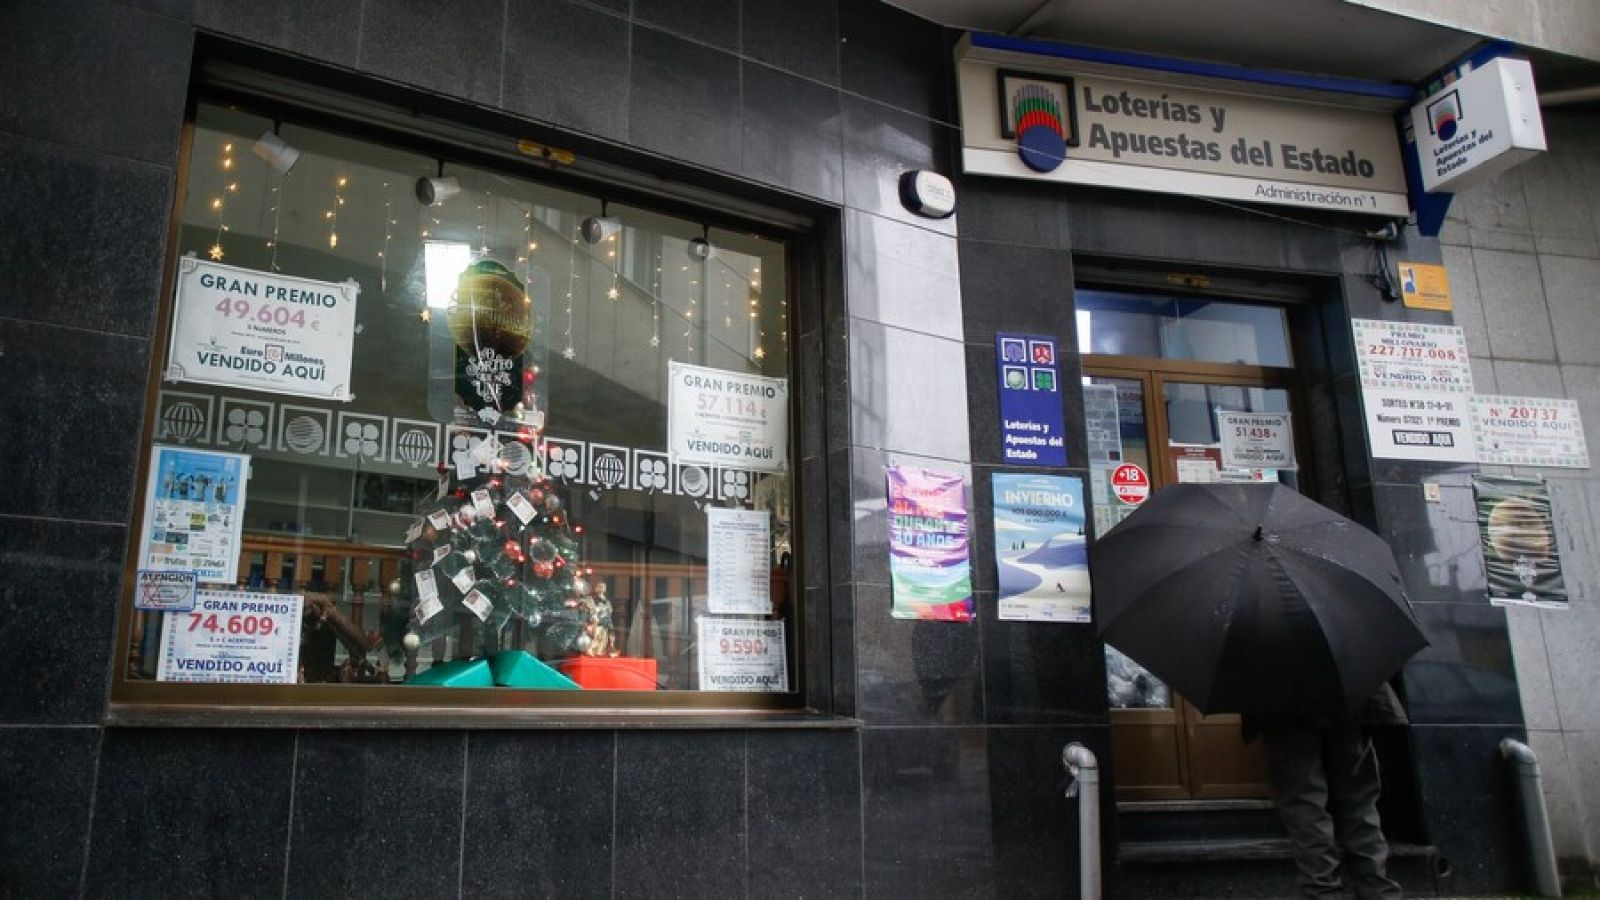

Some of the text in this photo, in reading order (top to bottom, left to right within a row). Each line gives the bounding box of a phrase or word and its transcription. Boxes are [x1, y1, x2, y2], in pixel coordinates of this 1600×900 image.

[1083, 86, 1226, 133] Loterías y
[1478, 129, 1494, 145] del
[1088, 122, 1375, 178] Apuestas del Estado
[1437, 156, 1468, 176] Estado
[1255, 184, 1352, 205] Administración
[1370, 195, 1377, 208] 1
[200, 273, 337, 309] GRAN PREMIO
[214, 296, 321, 332] 49.604 €
[240, 346, 264, 358] Euro
[197, 350, 277, 375] VENDIDO
[282, 362, 327, 382] AQUÍ
[684, 374, 776, 399] GRAN PREMIO
[1227, 416, 1250, 425] GRAN
[1482, 417, 1537, 428] VENDIDO
[687, 439, 742, 456] VENDIDO
[1048, 437, 1064, 447] del
[1006, 447, 1038, 460] Estado
[1005, 489, 1073, 508] INVIERNO
[203, 600, 289, 614] GRAN PREMIO
[187, 612, 274, 637] 74.609
[177, 658, 243, 672] VENDIDO
[246, 660, 283, 675] AQUÍ
